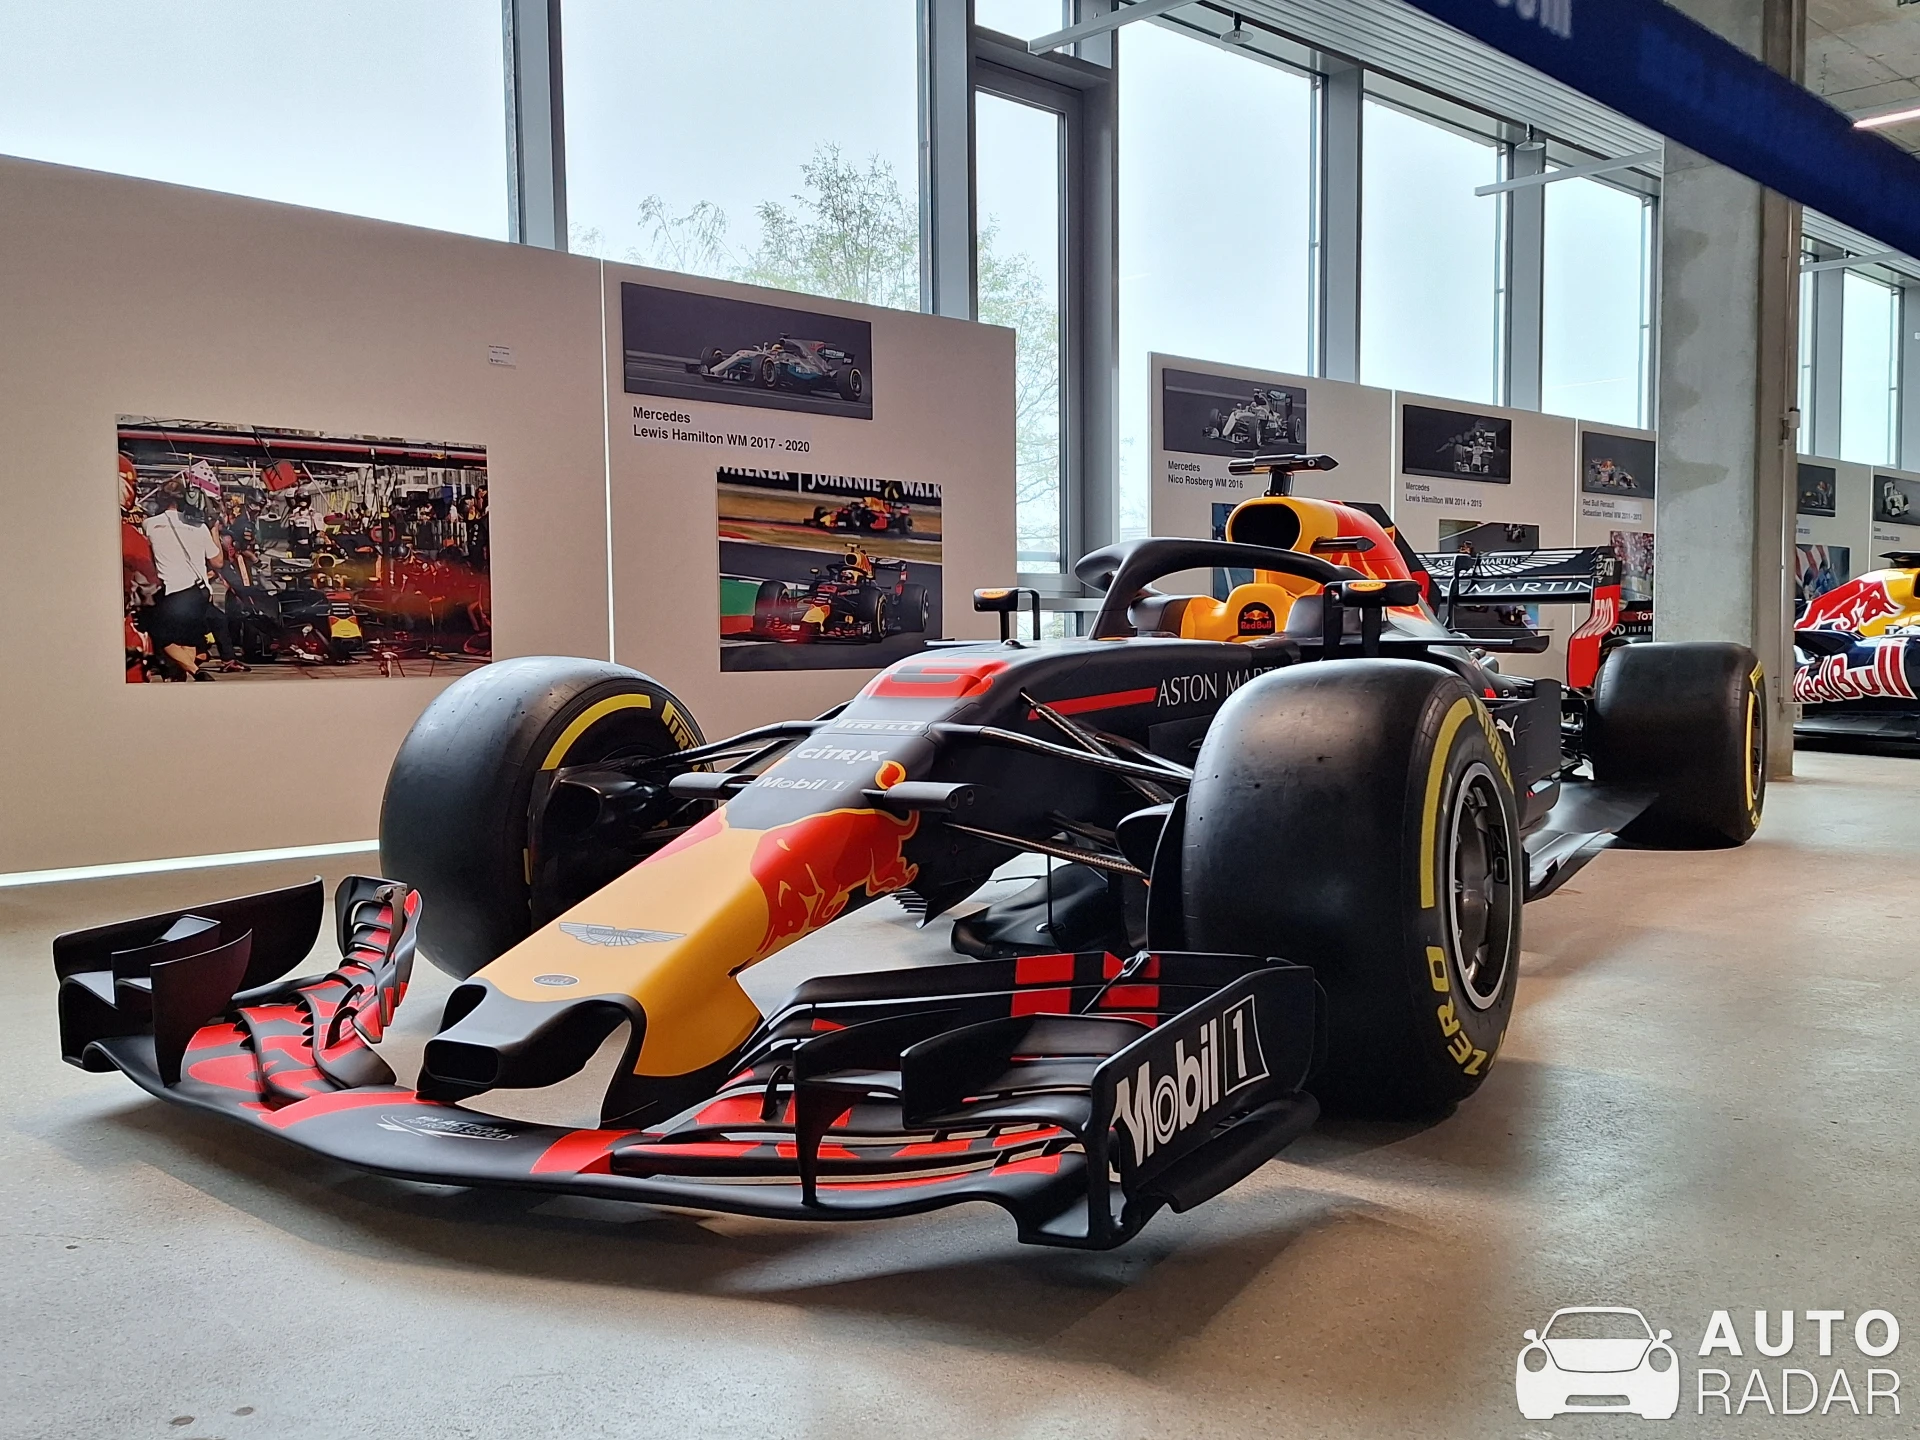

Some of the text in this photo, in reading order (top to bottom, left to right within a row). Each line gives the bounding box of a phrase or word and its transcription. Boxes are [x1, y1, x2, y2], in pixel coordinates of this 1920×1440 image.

[633, 406, 691, 423] Mercedes
[633, 424, 669, 439] Lewis
[672, 428, 723, 444] Hamilton
[727, 433, 748, 447] WM
[750, 436, 775, 449] 2017
[785, 439, 810, 452] 2020
[1168, 460, 1200, 472] Mercedes
[807, 474, 882, 492] JOHNNIE
[1168, 474, 1243, 488] Nico Rosberg WM 2016
[1405, 482, 1430, 491] Mercedes
[1405, 494, 1420, 502] Lewis
[1421, 495, 1443, 504] Hamilton
[1444, 497, 1453, 505] WM
[1480, 557, 1519, 566] MARTIN
[1241, 620, 1272, 629] Red Bull
[1157, 672, 1217, 707] ASTON
[835, 719, 926, 731] PIRELLI
[755, 776, 827, 790] Mobil
[1426, 946, 1487, 1075] ZERO
[1110, 1018, 1219, 1167] Mobil
